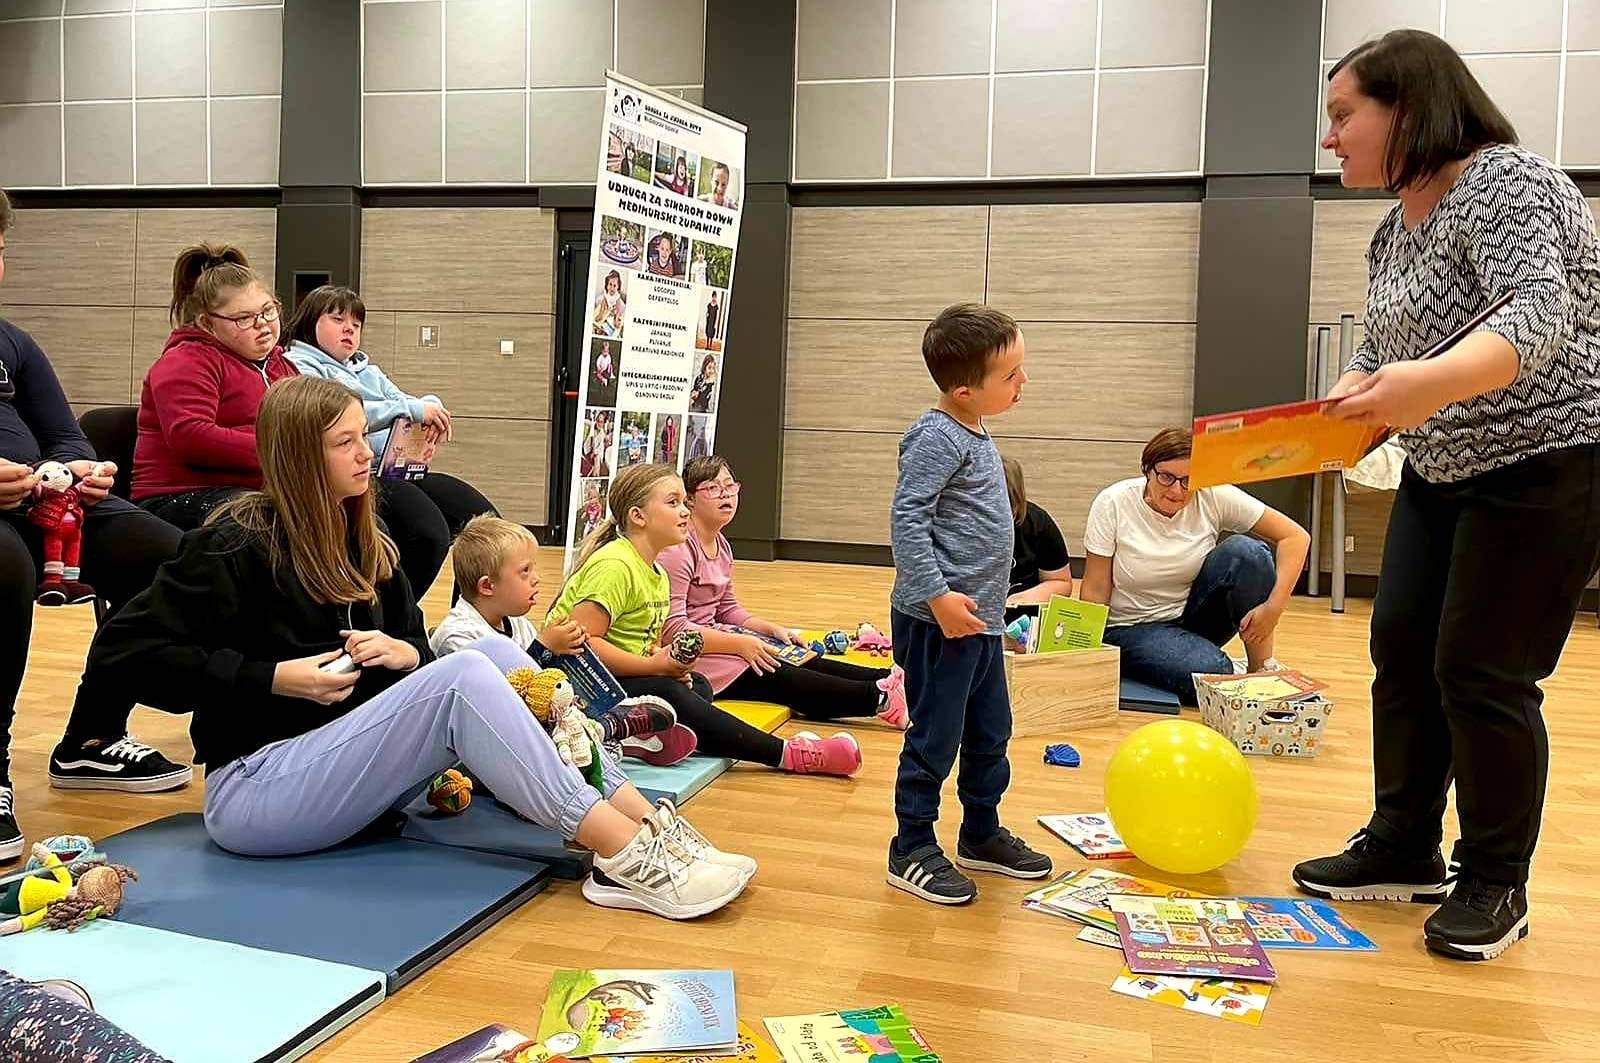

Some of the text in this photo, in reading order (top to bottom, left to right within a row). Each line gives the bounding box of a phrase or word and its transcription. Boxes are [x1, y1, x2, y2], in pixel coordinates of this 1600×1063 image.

[608, 180, 647, 202] UDRUGA
[649, 193, 662, 206] ZA
[706, 211, 734, 226] DOWN
